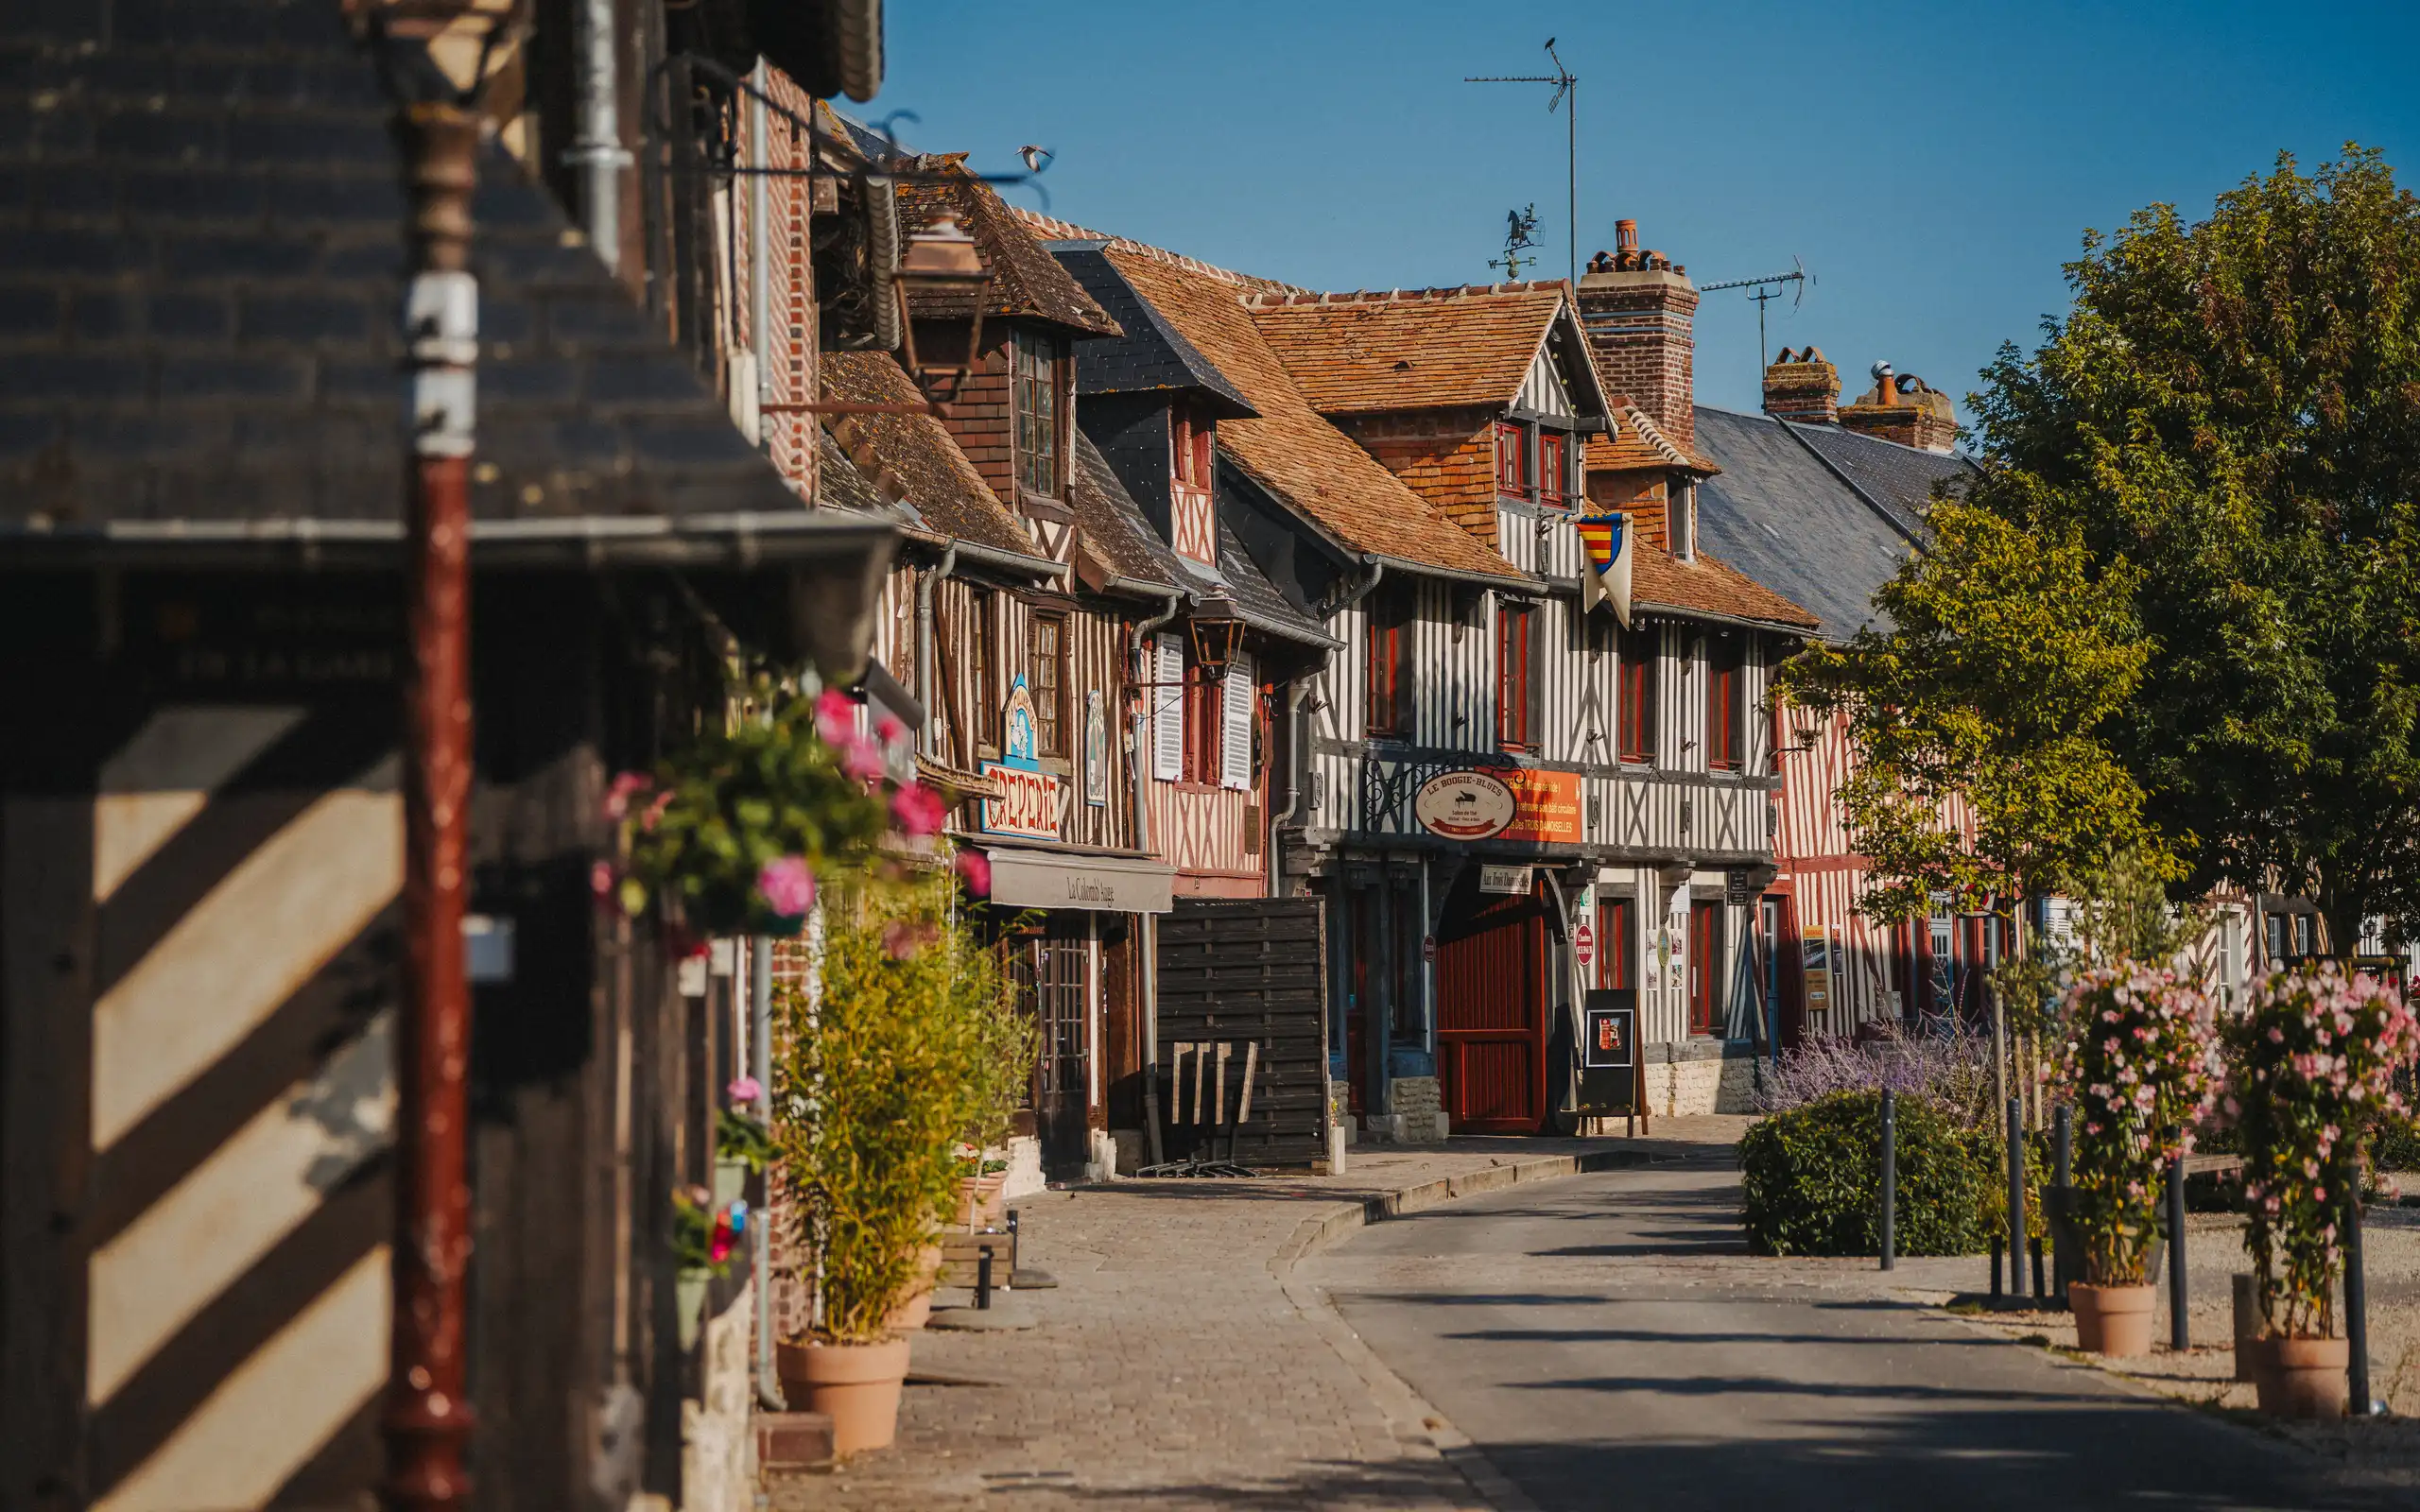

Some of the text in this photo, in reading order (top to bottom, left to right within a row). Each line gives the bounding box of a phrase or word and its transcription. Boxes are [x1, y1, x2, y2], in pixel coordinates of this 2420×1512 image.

[1426, 783, 1440, 796] LE
[1441, 776, 1503, 797] BOOGIE-BLUES
[1539, 803, 1547, 813] son
[1525, 819, 1539, 831] TROIS
[1540, 820, 1573, 833] DAMOISELLES
[1482, 870, 1530, 887] Aux Trois Damoiselles
[1066, 877, 1076, 899] La
